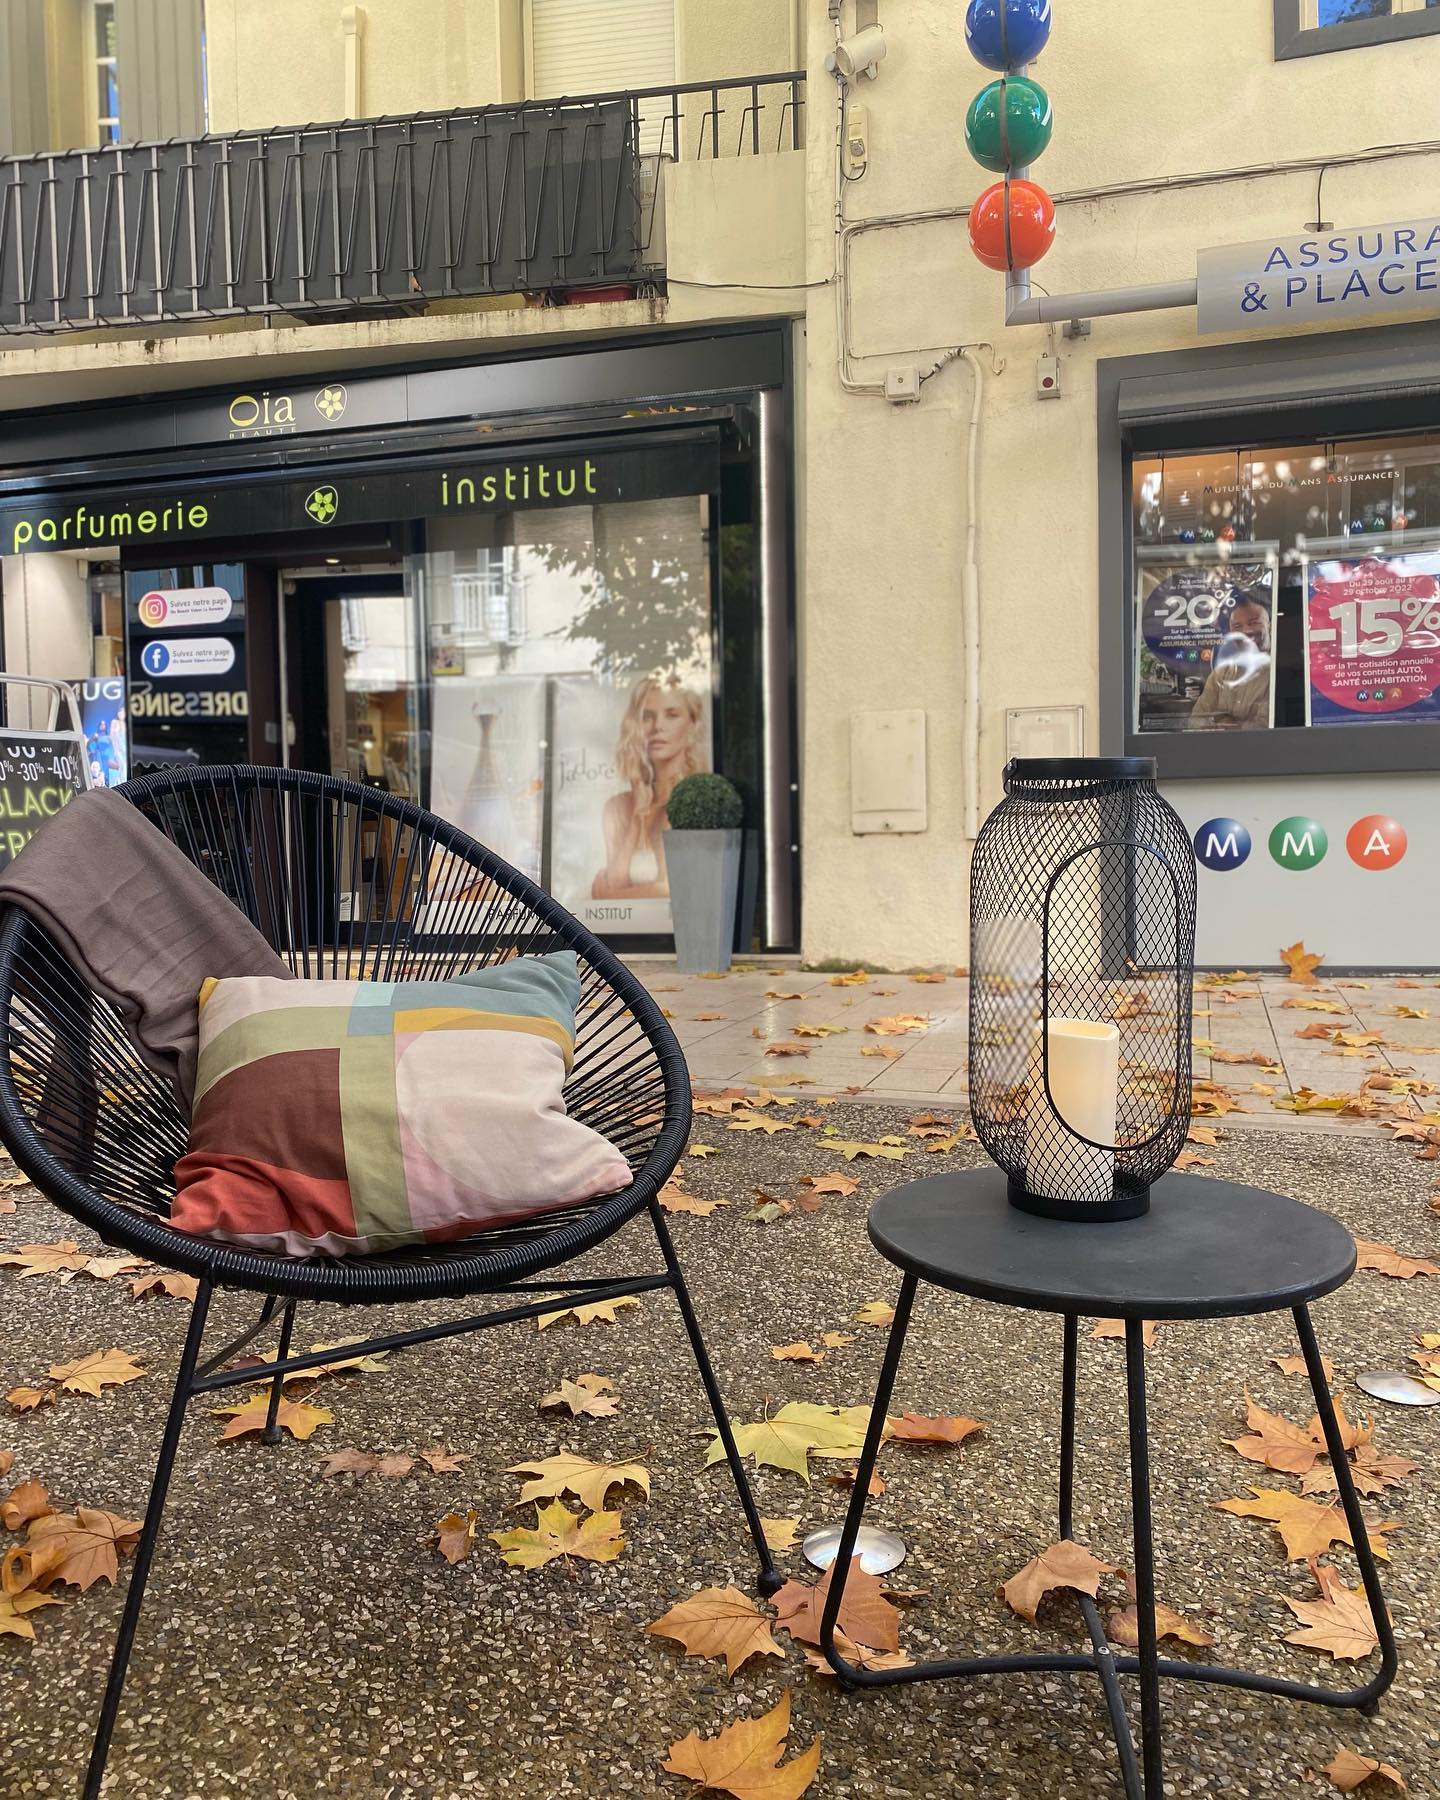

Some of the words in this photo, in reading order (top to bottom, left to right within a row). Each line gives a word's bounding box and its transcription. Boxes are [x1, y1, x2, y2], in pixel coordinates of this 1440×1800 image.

[1241, 282, 1268, 312] &
[1286, 258, 1438, 307] PLACE
[229, 392, 296, 427] Oïa
[441, 460, 597, 506] institut
[1269, 481, 1284, 489] DU
[1327, 471, 1400, 484] ASSURANCES
[13, 501, 208, 554] parfumerie
[1154, 589, 1236, 627] -20%
[1309, 597, 1440, 658] -15%
[1359, 659, 1398, 669] cotisation
[1399, 657, 1434, 666] annuelle
[1362, 668, 1395, 676] contrats
[1374, 675, 1427, 684] HABITATION
[17, 762, 45, 781] -30%
[585, 907, 633, 921] INSTITUT
